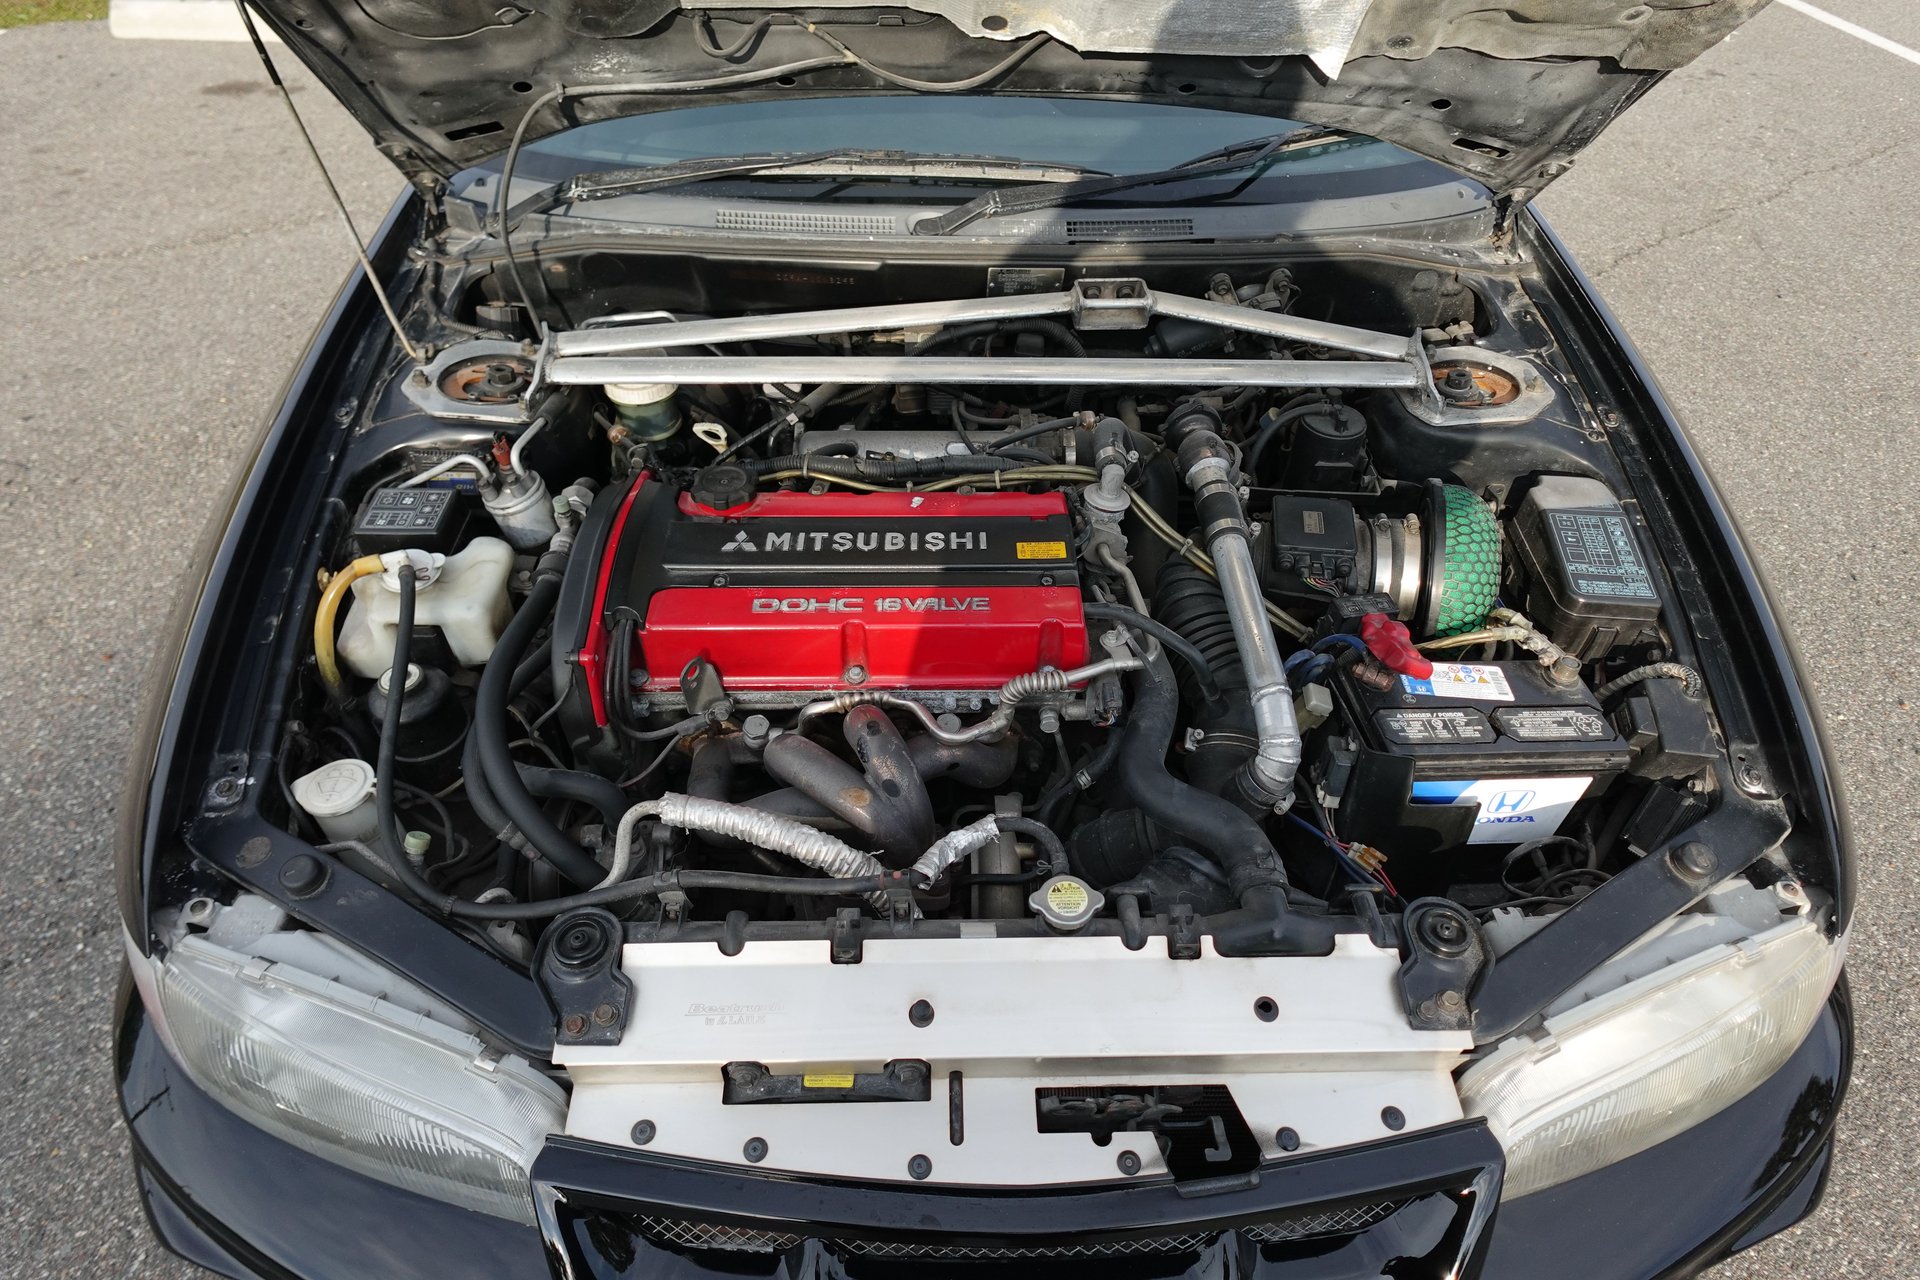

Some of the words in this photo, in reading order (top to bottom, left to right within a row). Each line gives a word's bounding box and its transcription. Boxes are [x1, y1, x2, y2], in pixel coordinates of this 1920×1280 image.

[765, 531, 988, 552] MITSUBISHI
[752, 597, 864, 613] DOHC
[1477, 816, 1535, 824] ONDA
